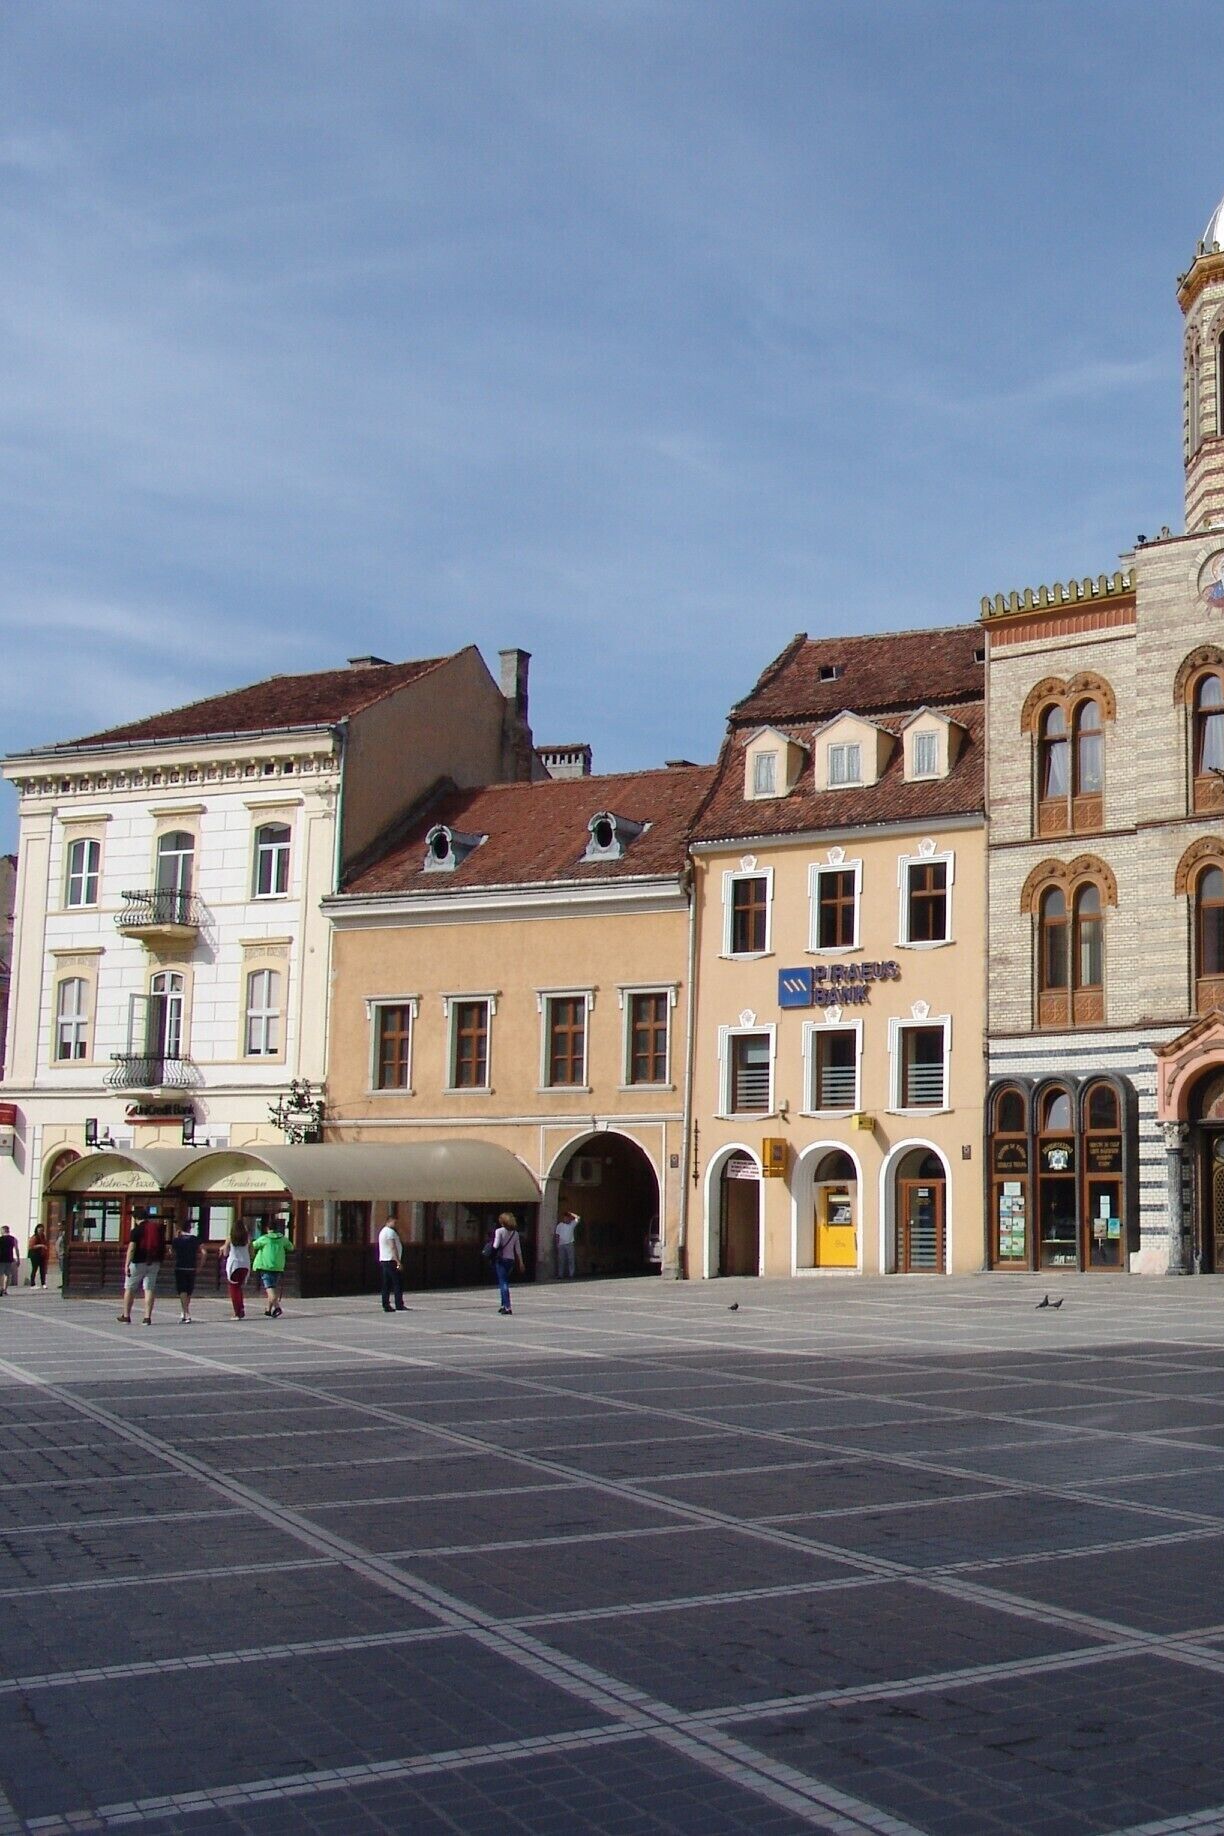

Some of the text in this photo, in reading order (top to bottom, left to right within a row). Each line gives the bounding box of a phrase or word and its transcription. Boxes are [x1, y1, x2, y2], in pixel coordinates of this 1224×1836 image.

[815, 961, 899, 982] PIRAEUS
[815, 984, 870, 1005] BANK
[135, 1103, 195, 1116] UniCredit Bank
